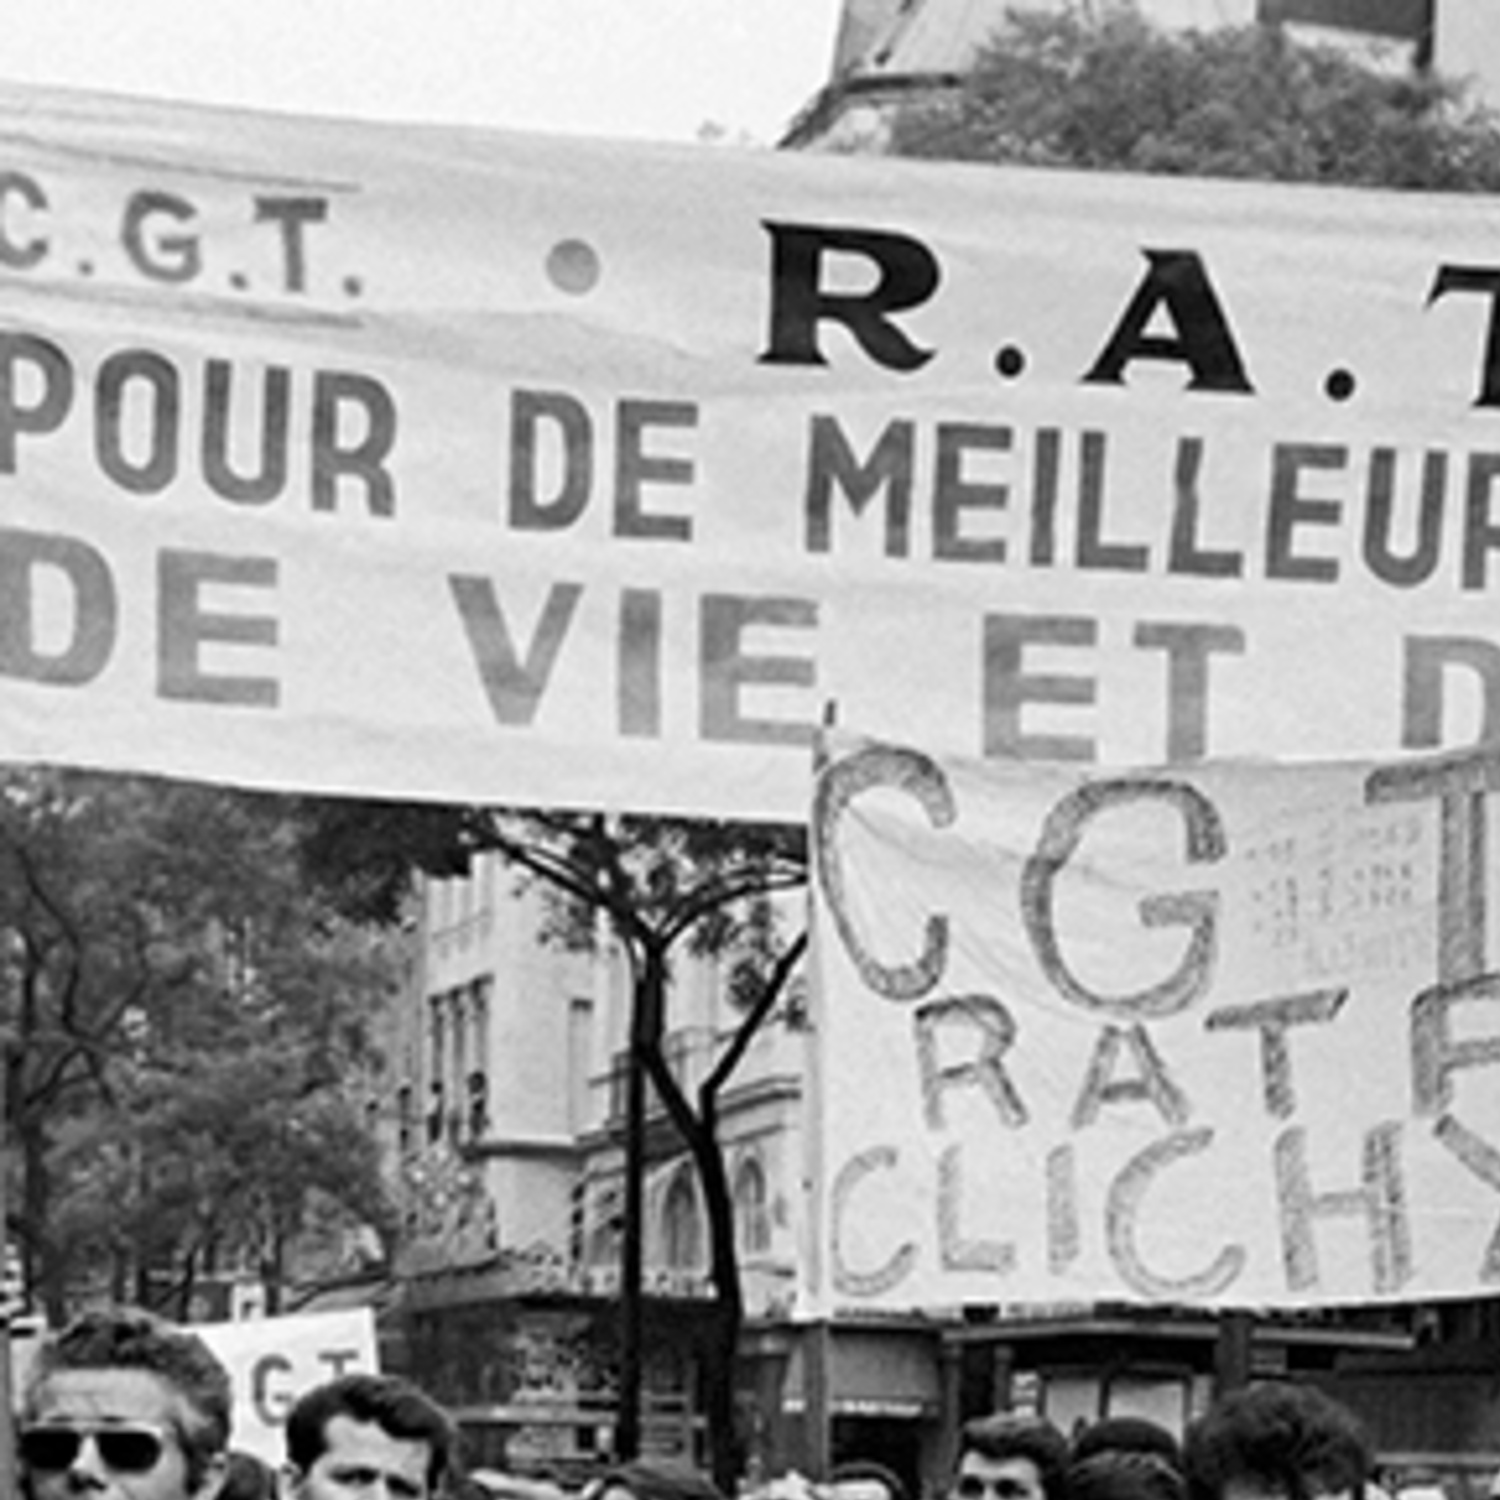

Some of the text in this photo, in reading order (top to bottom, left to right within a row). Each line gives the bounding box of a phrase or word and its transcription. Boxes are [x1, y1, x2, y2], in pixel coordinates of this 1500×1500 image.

[0, 331, 398, 518] POUR
[507, 388, 699, 542] DE
[0, 526, 280, 708] DE
[447, 572, 819, 747] VIE
[982, 613, 1246, 766] ET
